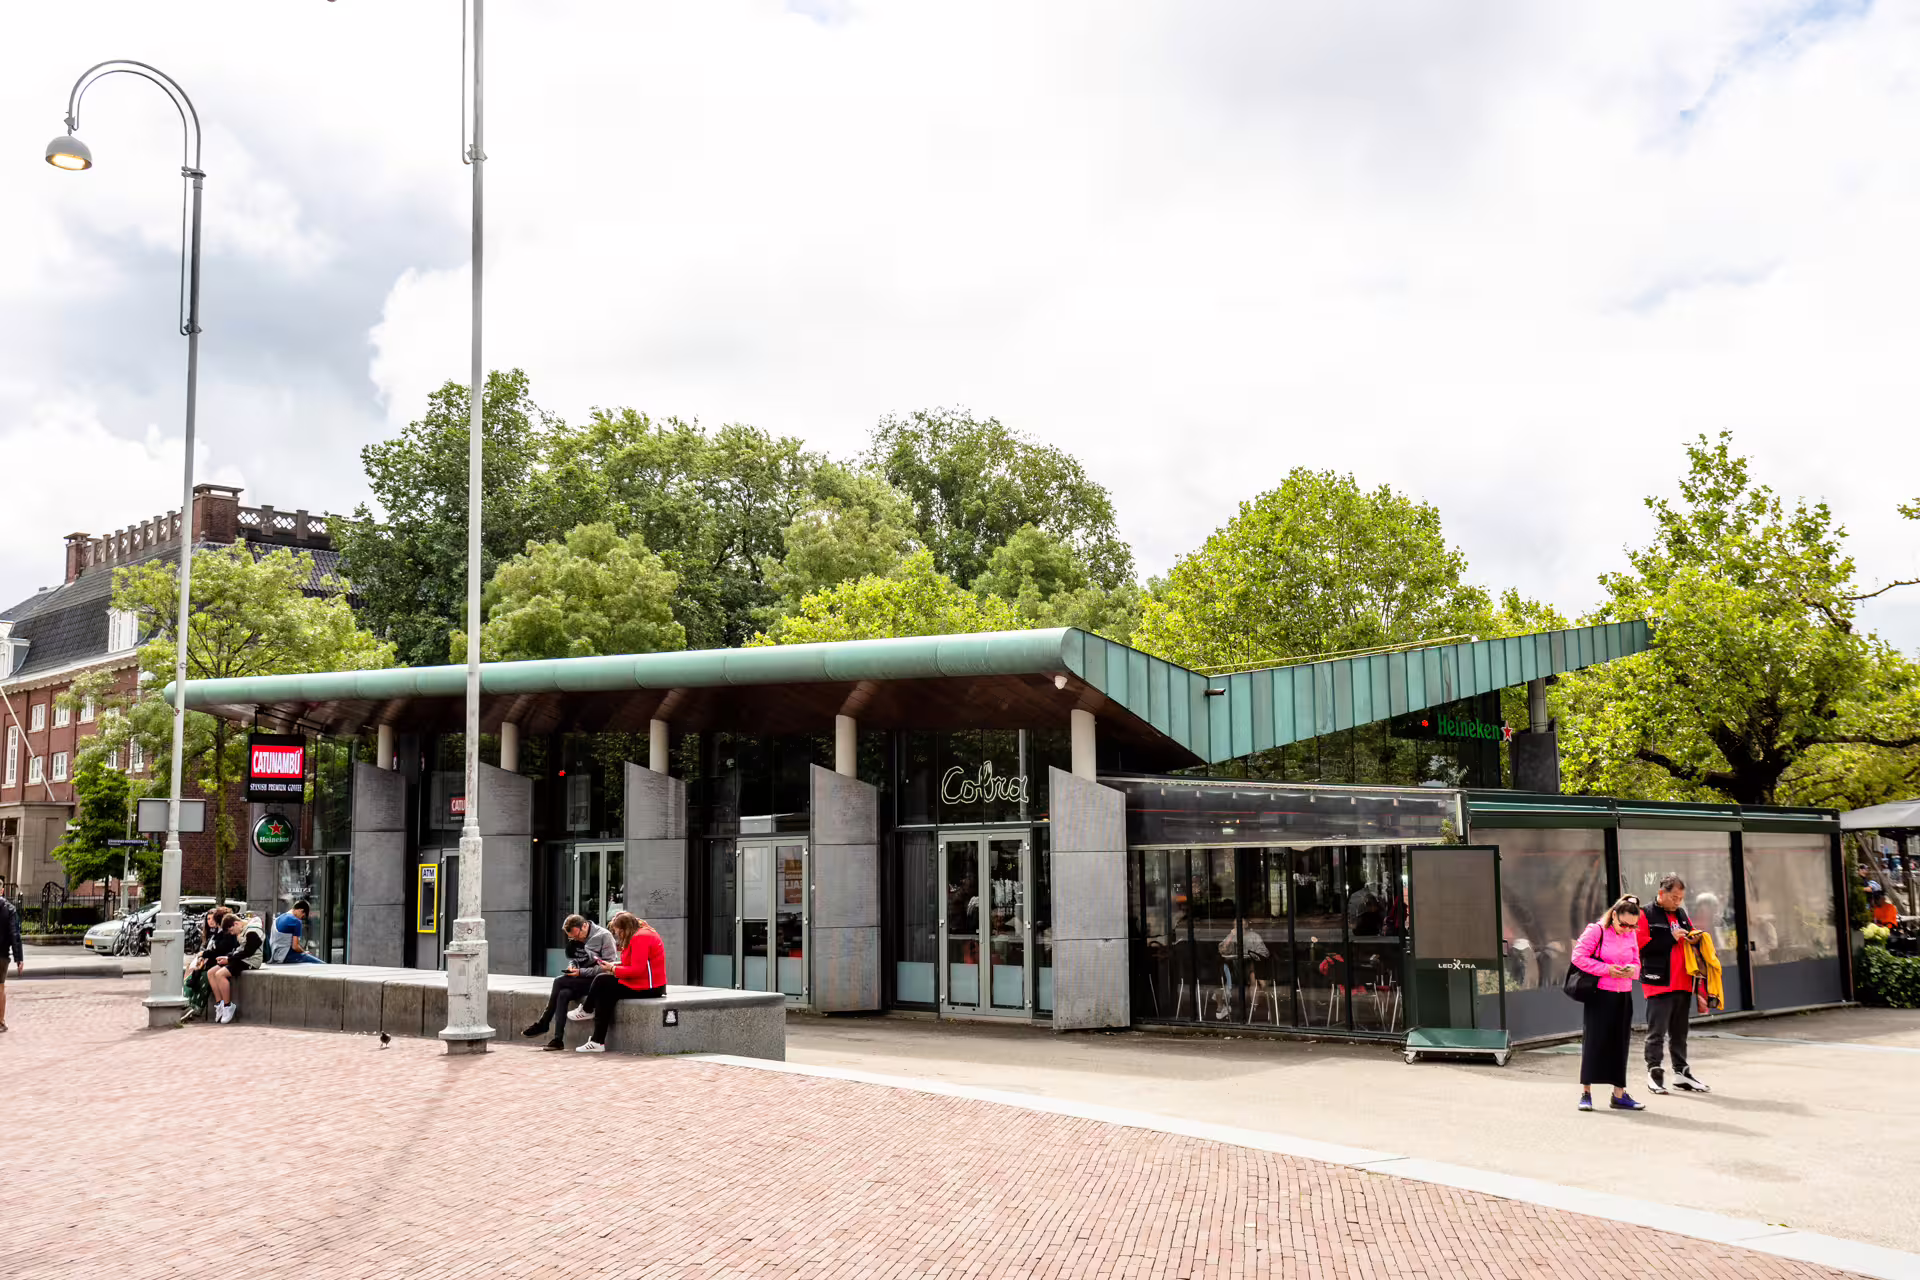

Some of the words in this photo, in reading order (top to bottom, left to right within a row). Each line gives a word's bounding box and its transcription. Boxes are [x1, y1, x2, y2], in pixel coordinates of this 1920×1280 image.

[1437, 713, 1500, 740] Heineken
[941, 760, 1029, 804] Cobra
[423, 868, 435, 878] ATM
